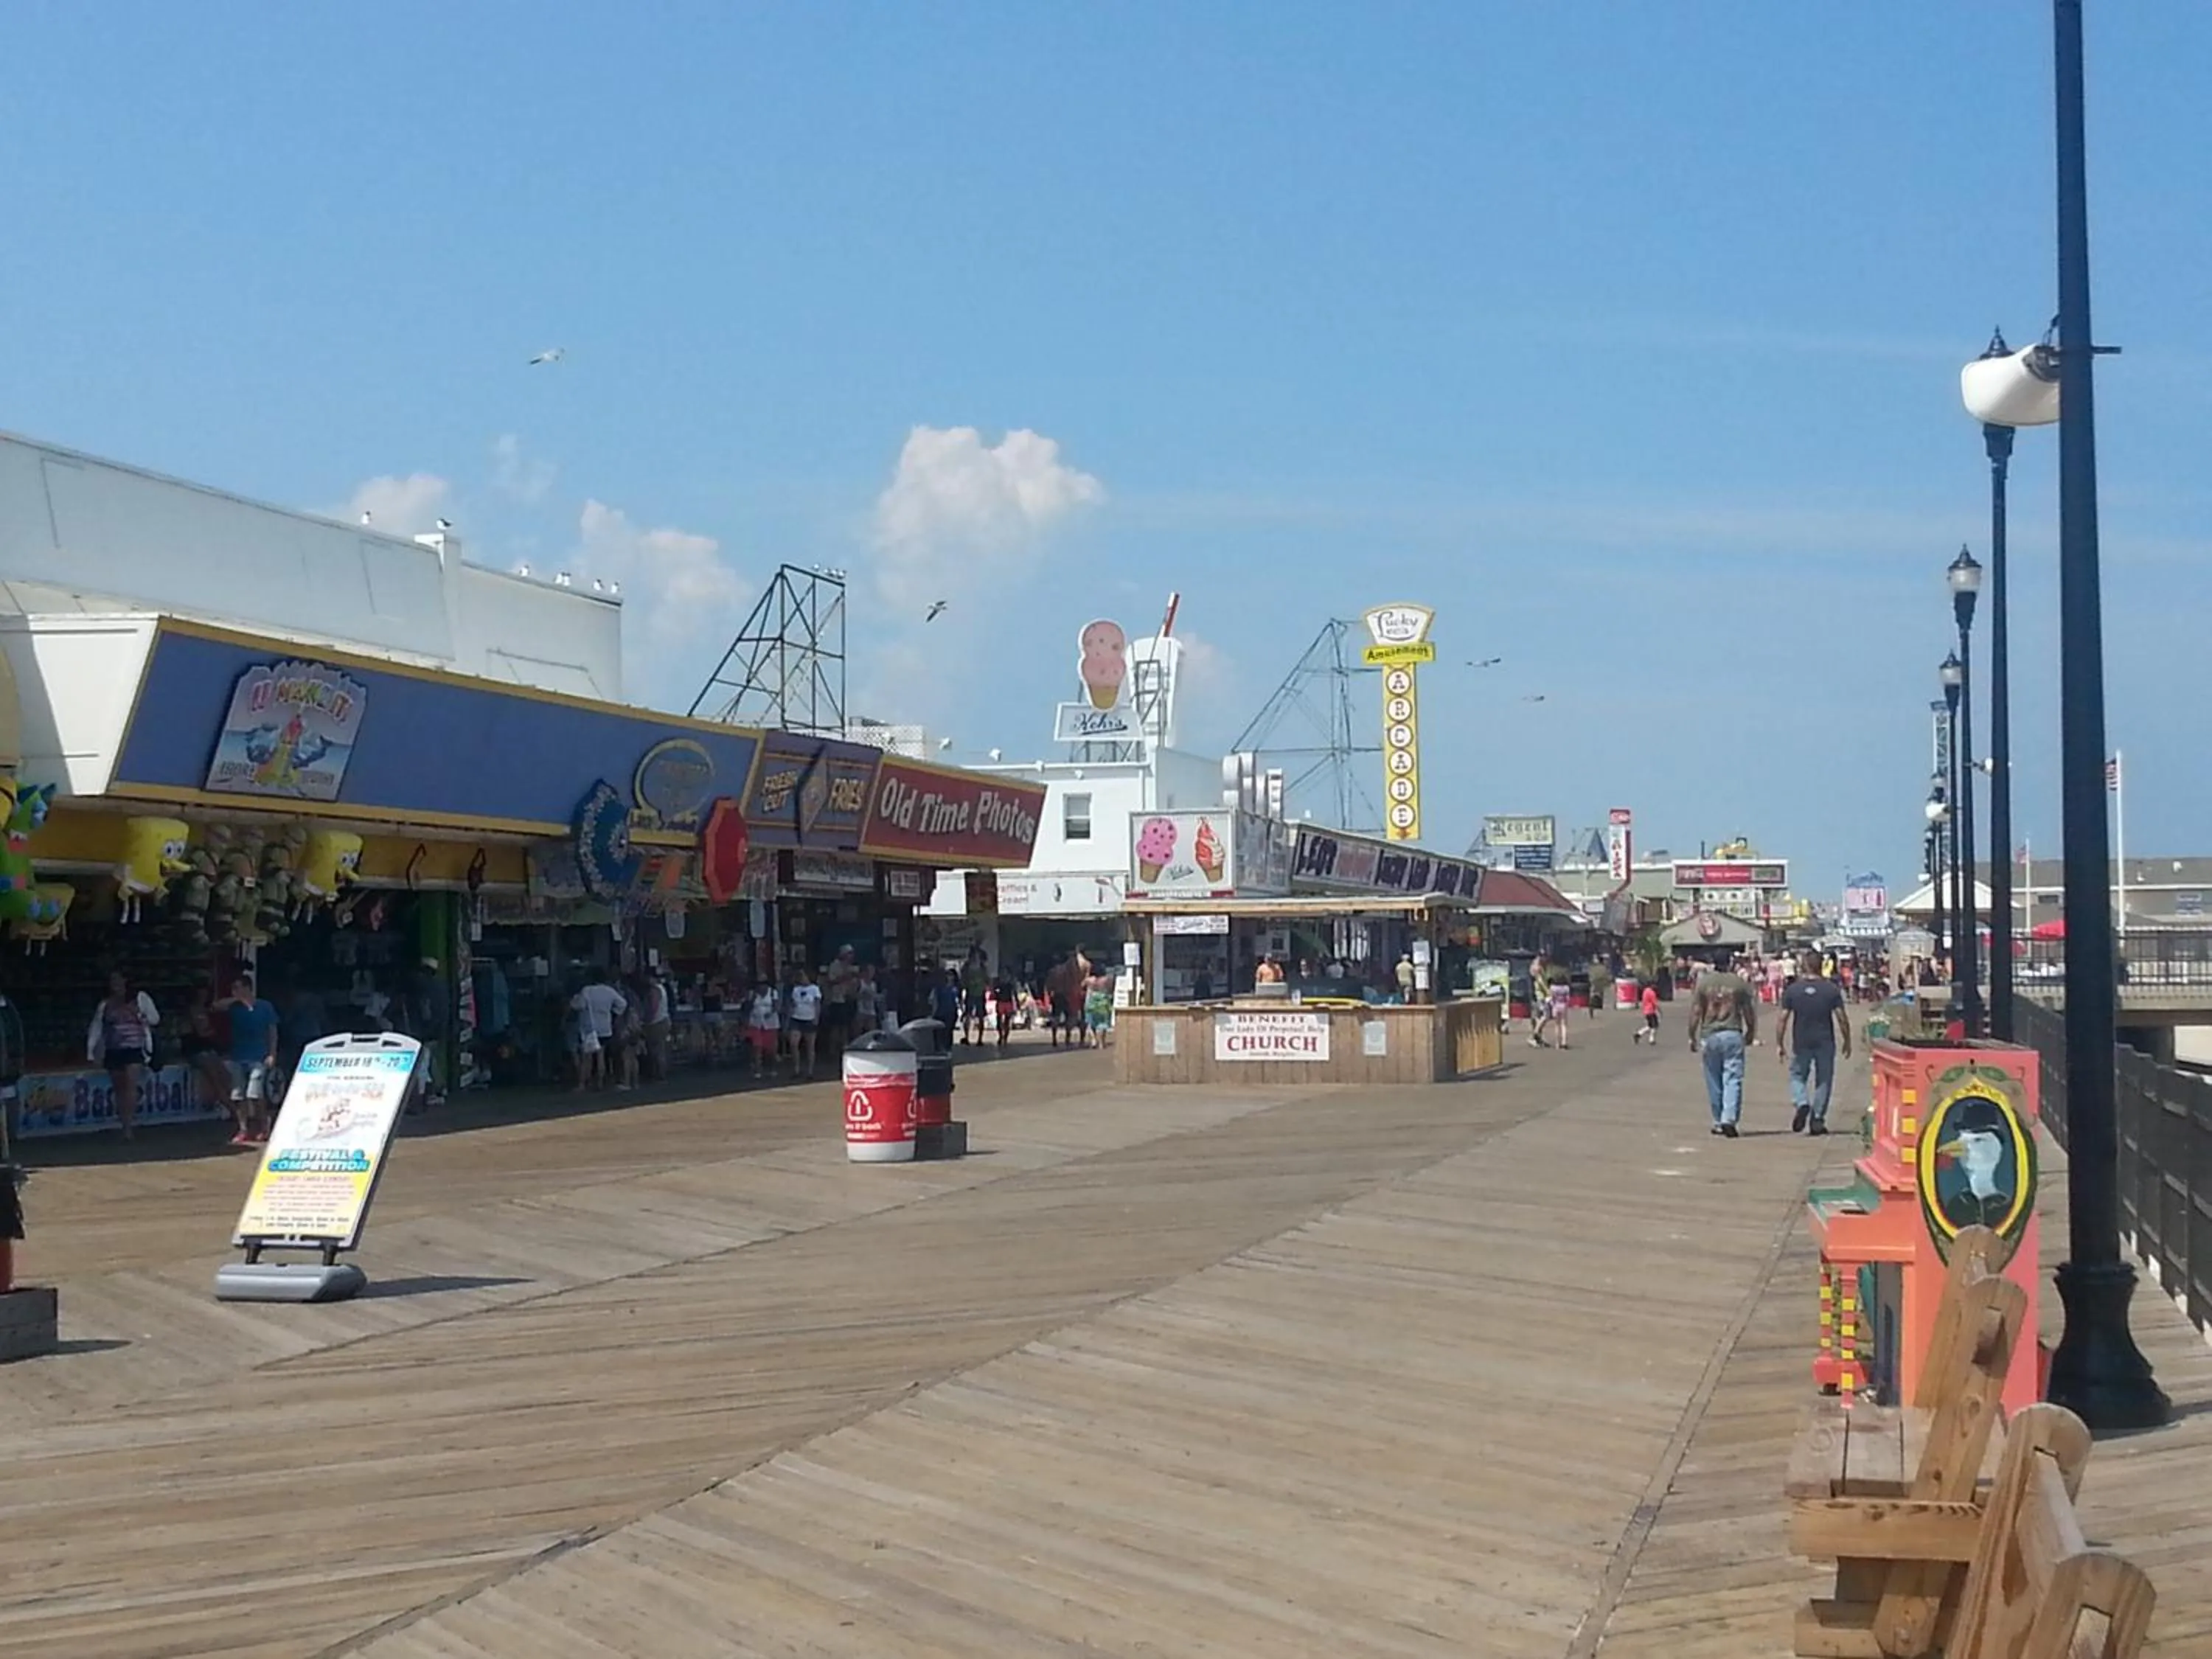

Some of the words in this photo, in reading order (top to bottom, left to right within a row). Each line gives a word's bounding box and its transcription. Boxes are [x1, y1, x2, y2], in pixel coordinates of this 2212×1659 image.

[1374, 611, 1419, 639] Lucky
[1392, 674, 1408, 824] ARCADE
[828, 778, 866, 811] FRIES
[880, 776, 917, 830] Old
[919, 793, 970, 834] Time
[973, 790, 1034, 845] Photos
[997, 884, 1027, 893] affles
[1237, 1014, 1306, 1023] BENEFIT
[1227, 1035, 1318, 1052] CHURCH
[307, 1056, 361, 1069] SEPTEMBER
[279, 1148, 349, 1161] FESTIVAL
[268, 1160, 369, 1172] COMPETITION
